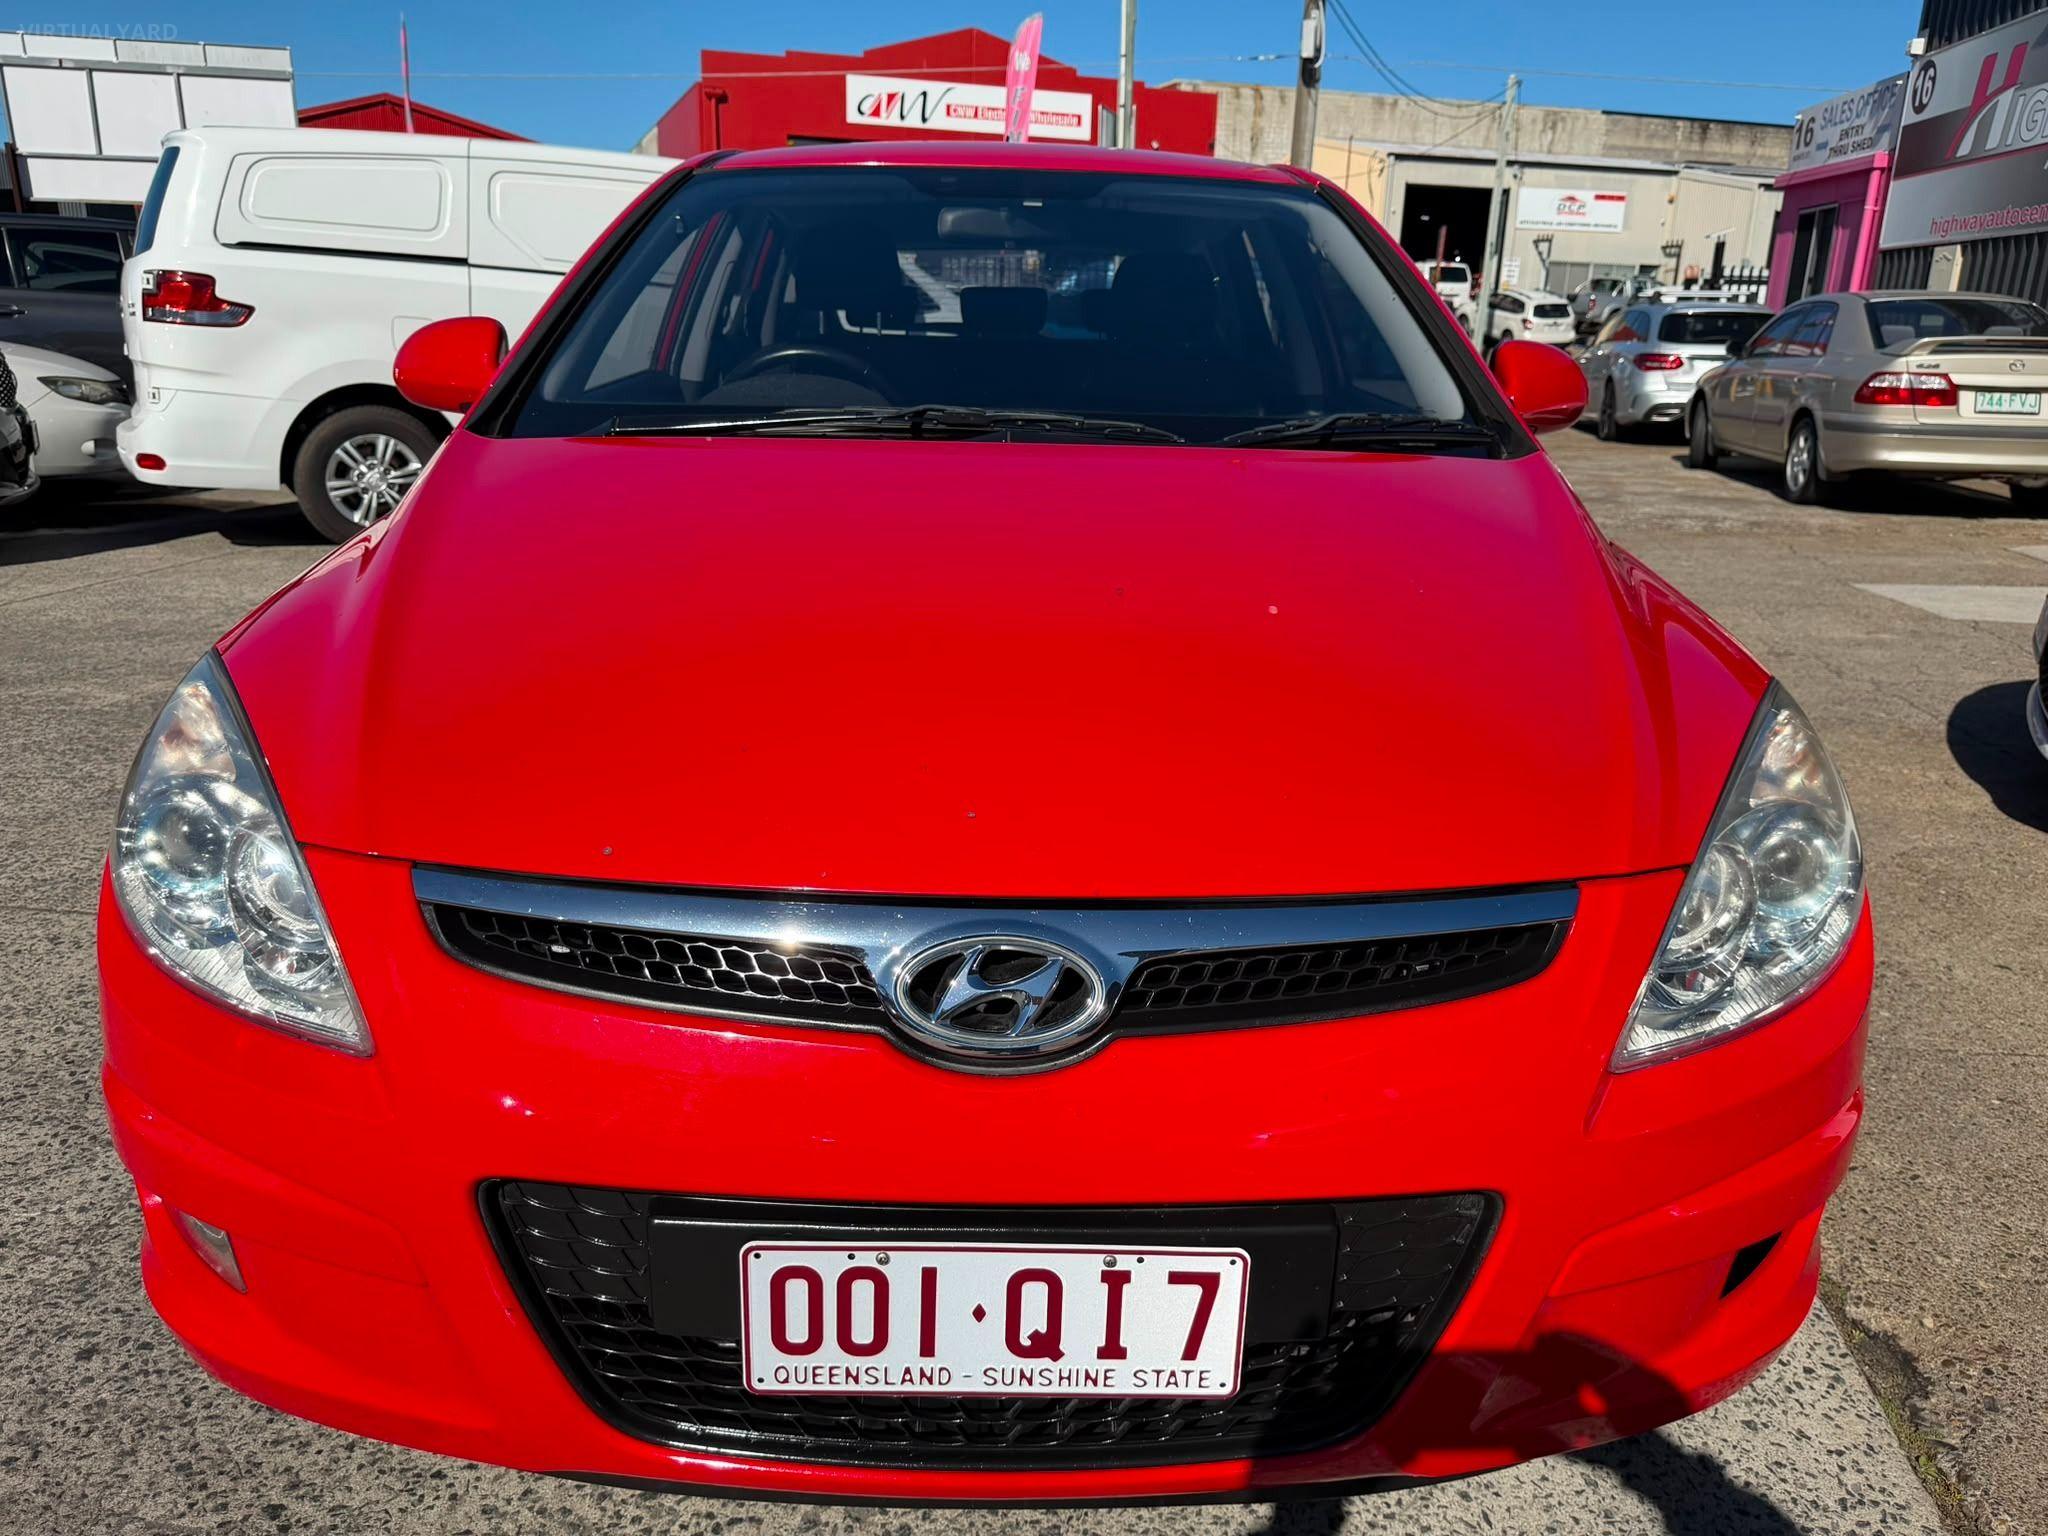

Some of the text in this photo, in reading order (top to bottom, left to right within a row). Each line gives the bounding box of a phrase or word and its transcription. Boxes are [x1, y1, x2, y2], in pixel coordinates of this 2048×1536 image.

[1913, 67, 1935, 108] 16
[1820, 83, 1898, 131] SALES OFFICE
[1794, 116, 1816, 150] 16
[1839, 123, 1865, 142] ENTRY
[1827, 143, 1850, 160] THRU
[1850, 136, 1873, 153] SHED
[774, 1365, 952, 1386] QUEENSLAND
[982, 1367, 1116, 1388] SUNSHINE
[1132, 1369, 1211, 1389] STATE
